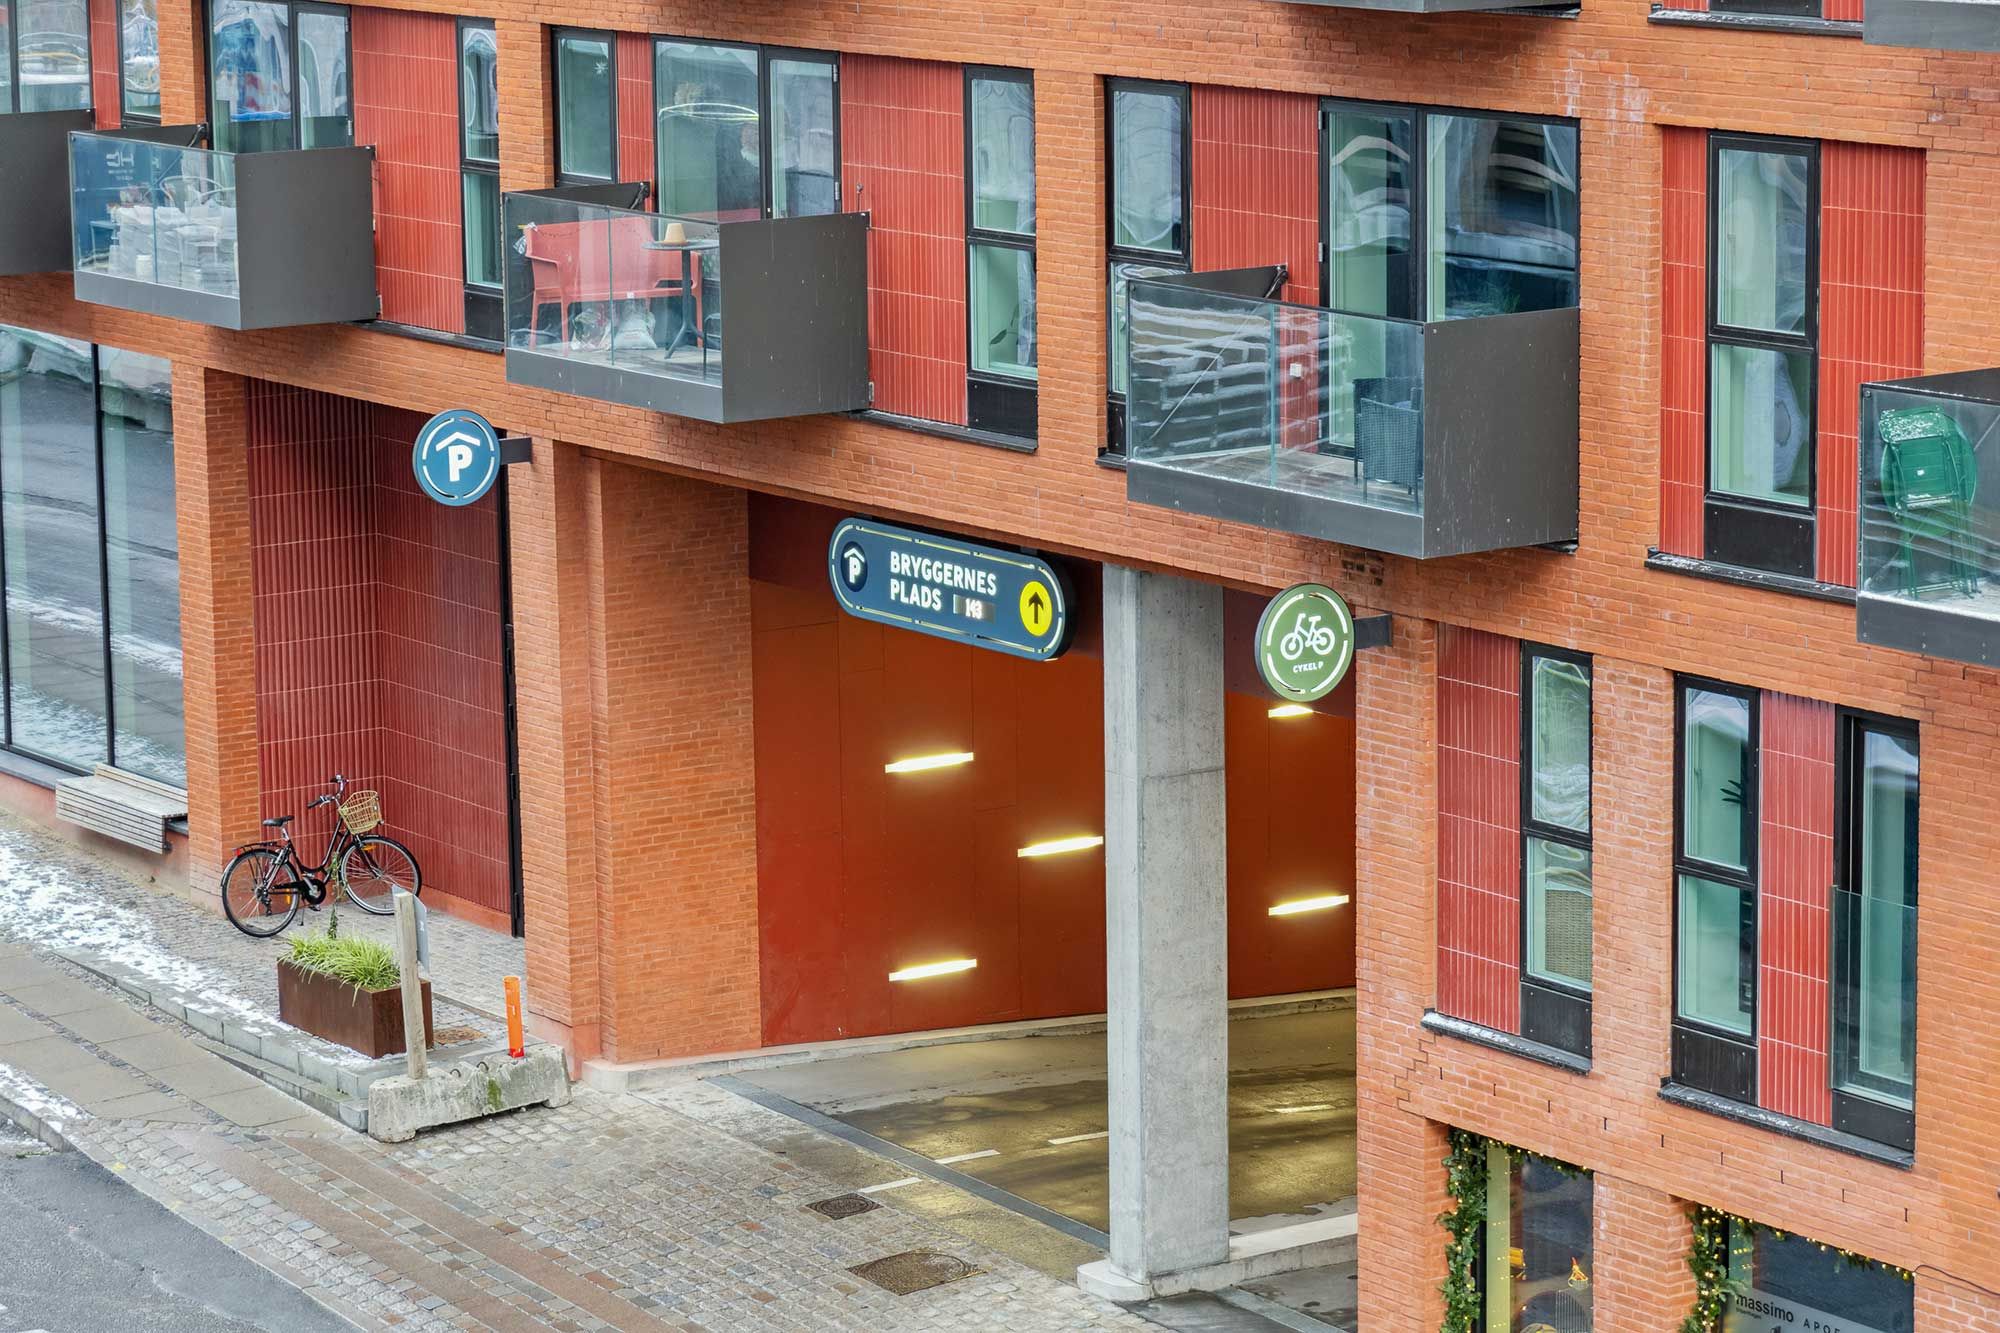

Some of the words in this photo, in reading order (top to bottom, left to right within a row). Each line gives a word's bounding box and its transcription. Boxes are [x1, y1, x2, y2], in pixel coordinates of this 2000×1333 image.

[448, 444, 473, 482] P
[849, 556, 861, 584] P
[890, 551, 997, 596] BRYGGERNES
[890, 578, 942, 612] PLADS
[1292, 663, 1317, 674] CYKEL
[1736, 1294, 1794, 1323] massimo
